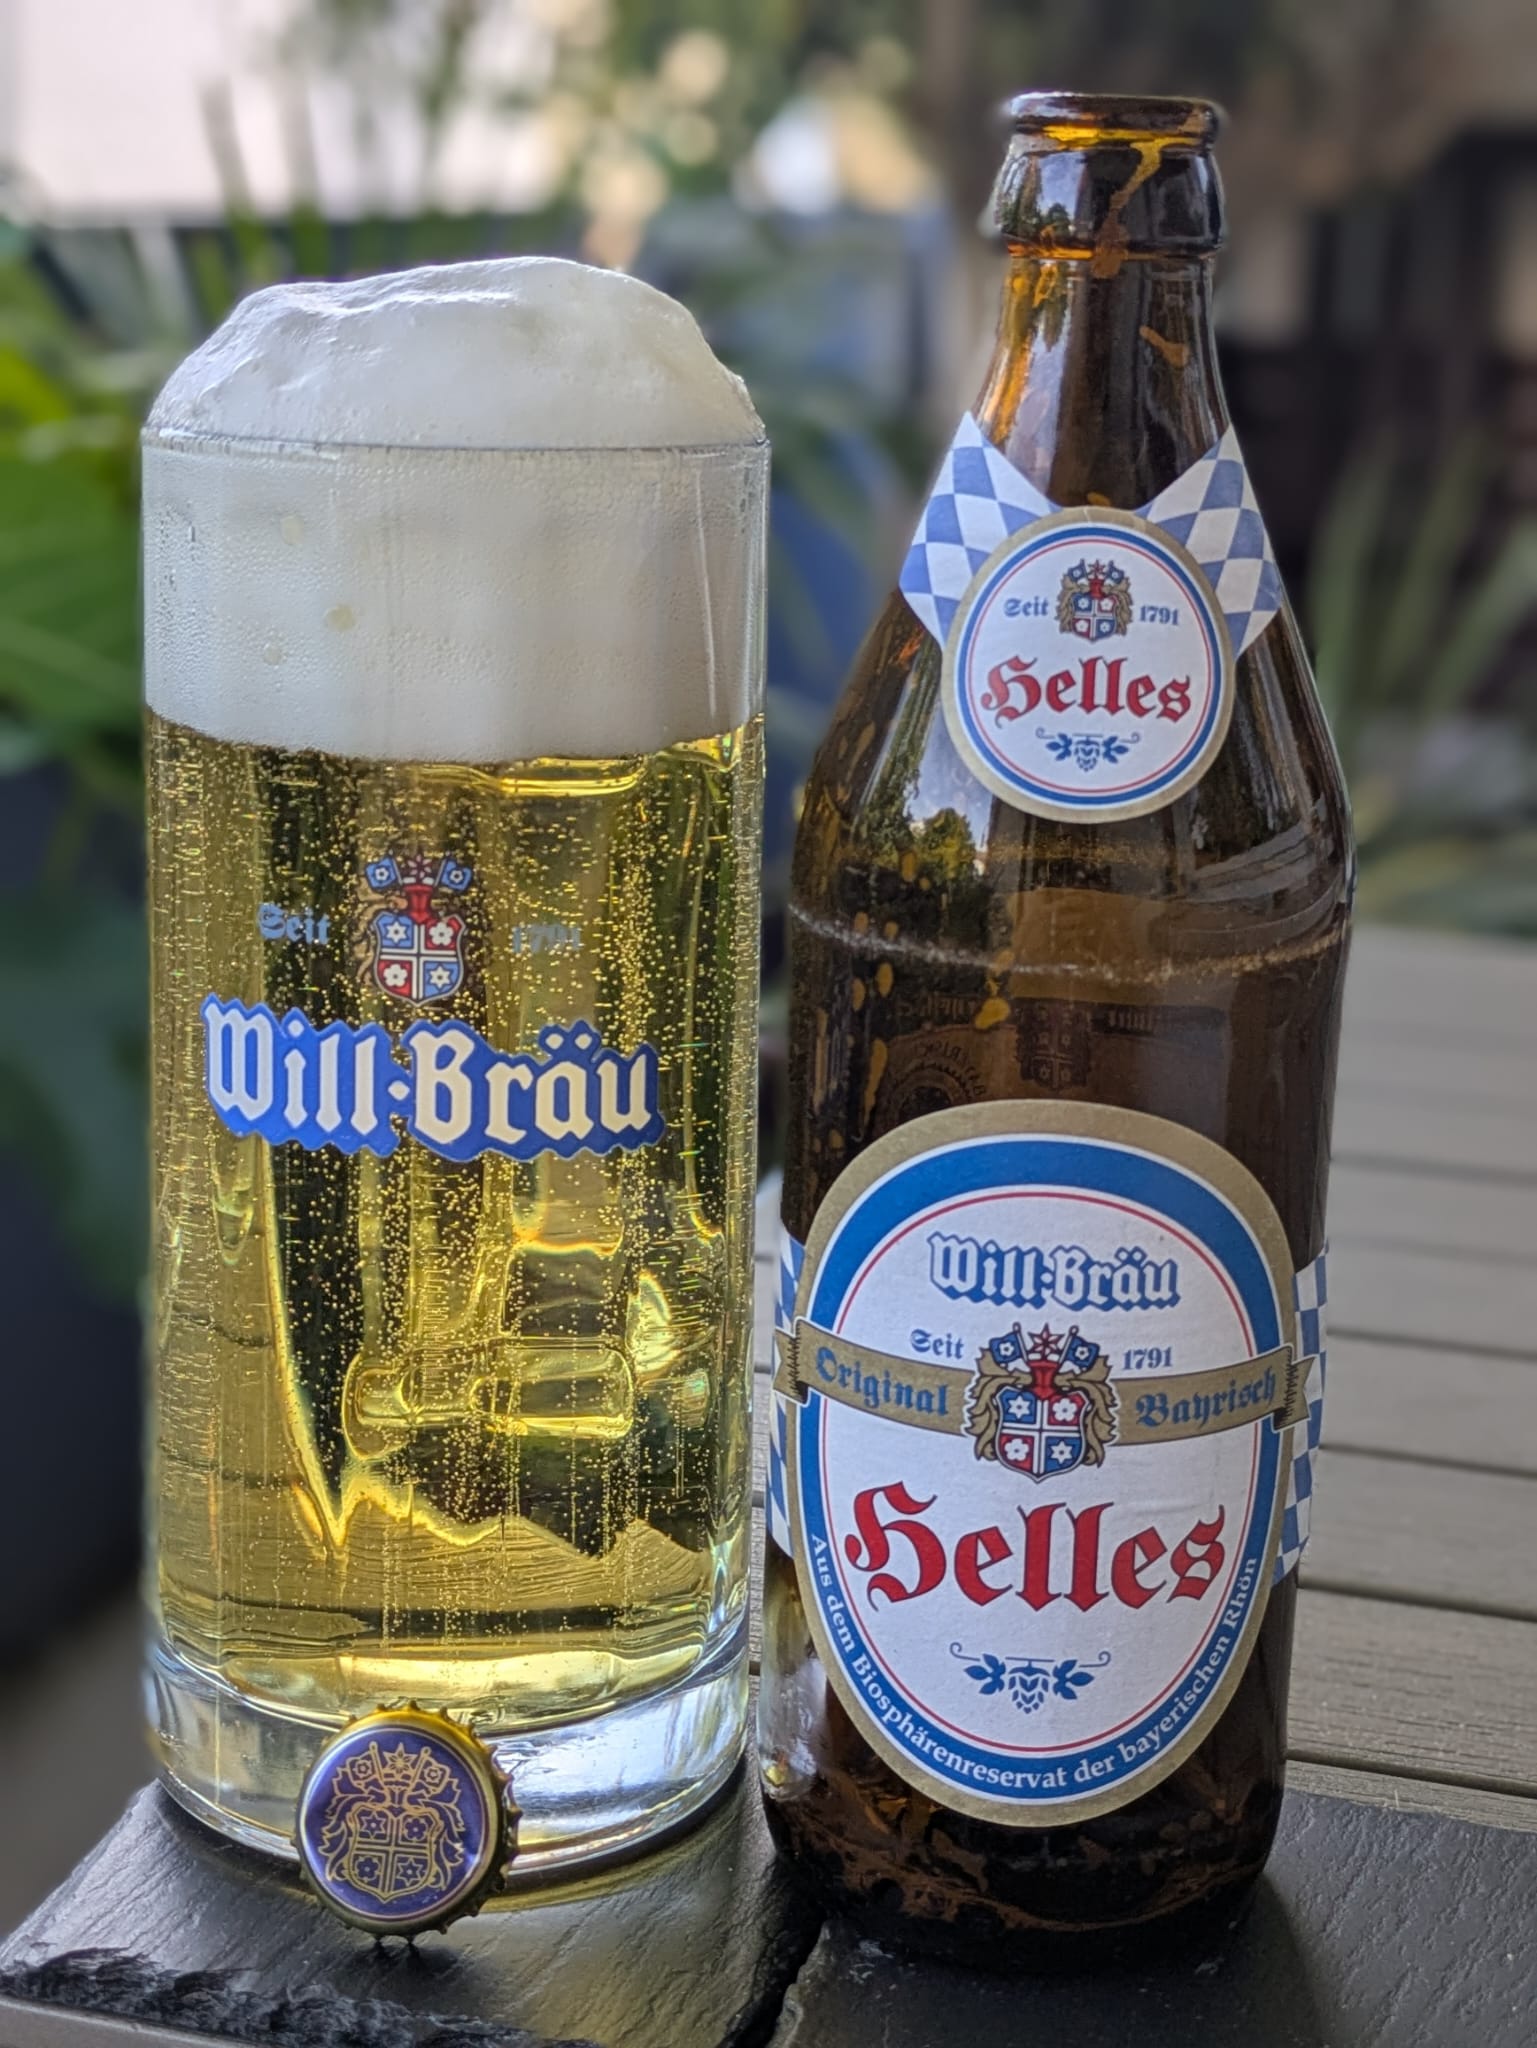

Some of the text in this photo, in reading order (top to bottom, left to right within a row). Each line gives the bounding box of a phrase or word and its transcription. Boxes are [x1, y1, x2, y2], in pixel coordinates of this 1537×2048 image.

[1003, 596, 1180, 626] Seit 1791
[980, 655, 1192, 728] Helles
[257, 902, 331, 945] Seit
[909, 1328, 1173, 1370] Seit 1791
[814, 1346, 1276, 1427] Original Bayrisch
[844, 1481, 1226, 1612] Helles
[811, 1534, 1258, 1789] Aus dem Biosphärenreservat der bayerischen Rhön
